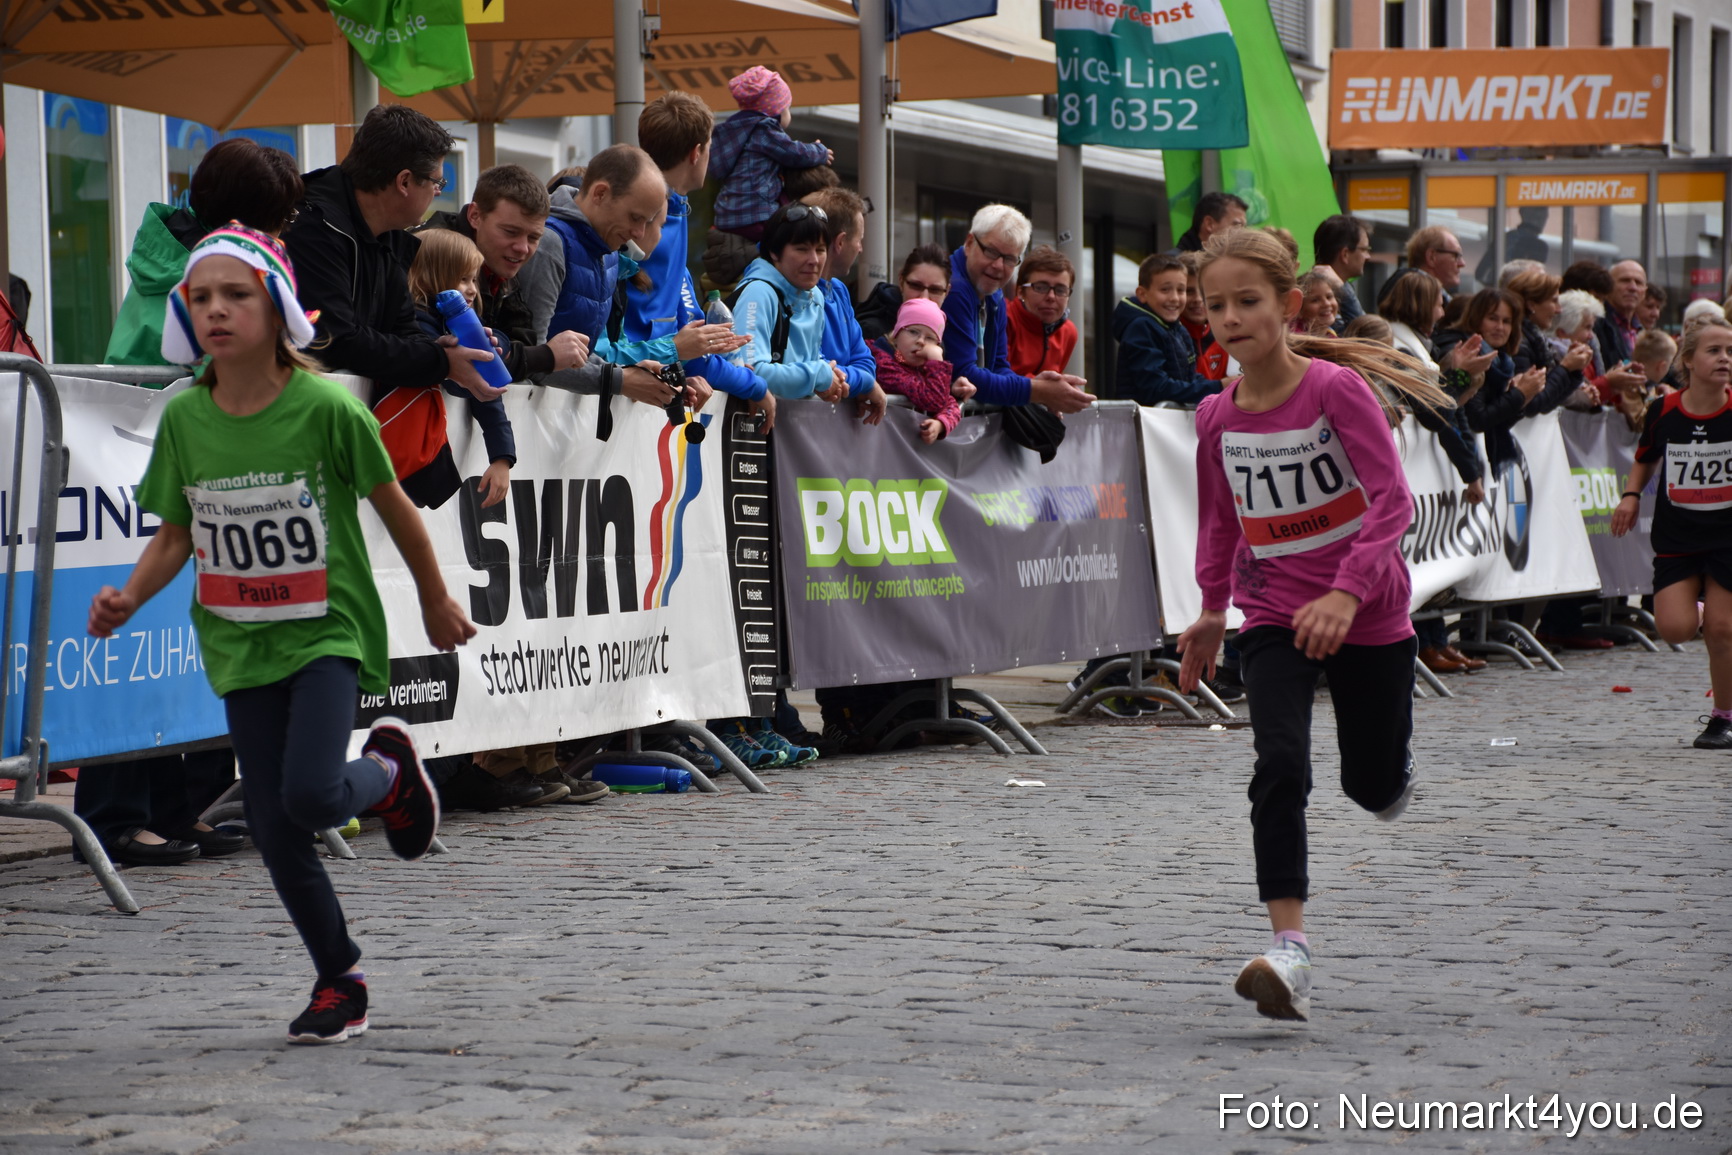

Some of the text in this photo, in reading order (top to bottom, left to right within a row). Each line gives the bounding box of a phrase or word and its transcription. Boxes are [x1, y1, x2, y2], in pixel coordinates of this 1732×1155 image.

[1061, 93, 1198, 131] 81 6352
[1341, 75, 1650, 122] RUNMARKT.DE
[1518, 180, 1636, 200] RUNMARKT.DE
[1226, 441, 1317, 459] PARTL Neumarkt
[1668, 449, 1732, 458] PARTL Neumarkt
[739, 462, 758, 475] Erdgas
[1235, 452, 1344, 511] 7170
[223, 498, 294, 516] Neumarkt
[742, 504, 760, 516] Wasser
[801, 489, 948, 555] BOCK
[1268, 514, 1331, 540] Leonie
[198, 516, 318, 571] 7069
[806, 573, 965, 606] inspired by smart concepts
[481, 626, 669, 696] stadtwerke neumarkt
[389, 678, 447, 706] verbinden
